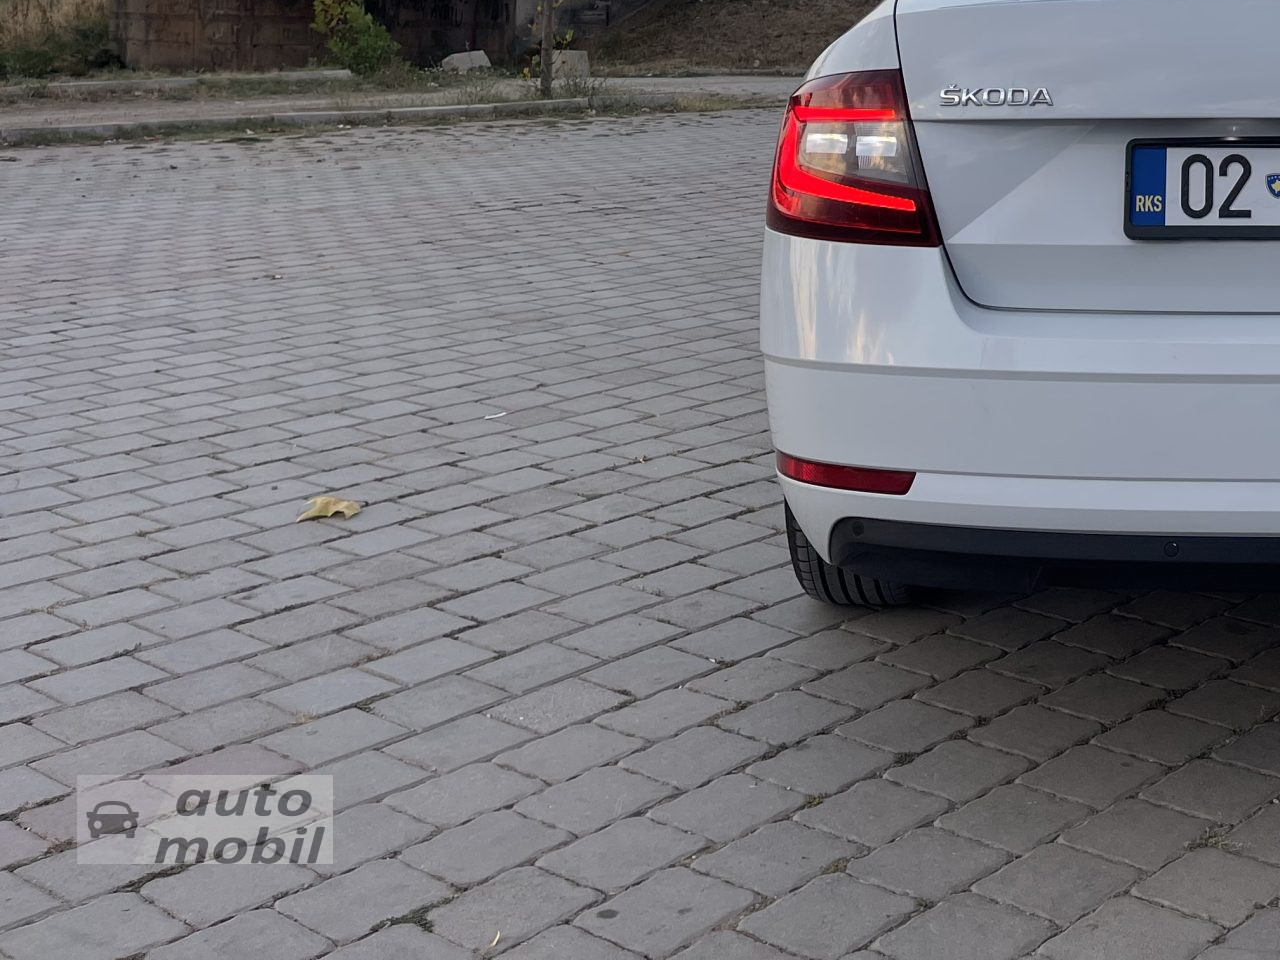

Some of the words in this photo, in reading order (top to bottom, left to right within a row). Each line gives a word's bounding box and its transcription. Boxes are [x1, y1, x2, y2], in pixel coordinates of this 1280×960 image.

[939, 84, 1054, 106] ŠKODA
[1180, 153, 1252, 219] 02
[1135, 194, 1163, 212] RKS
